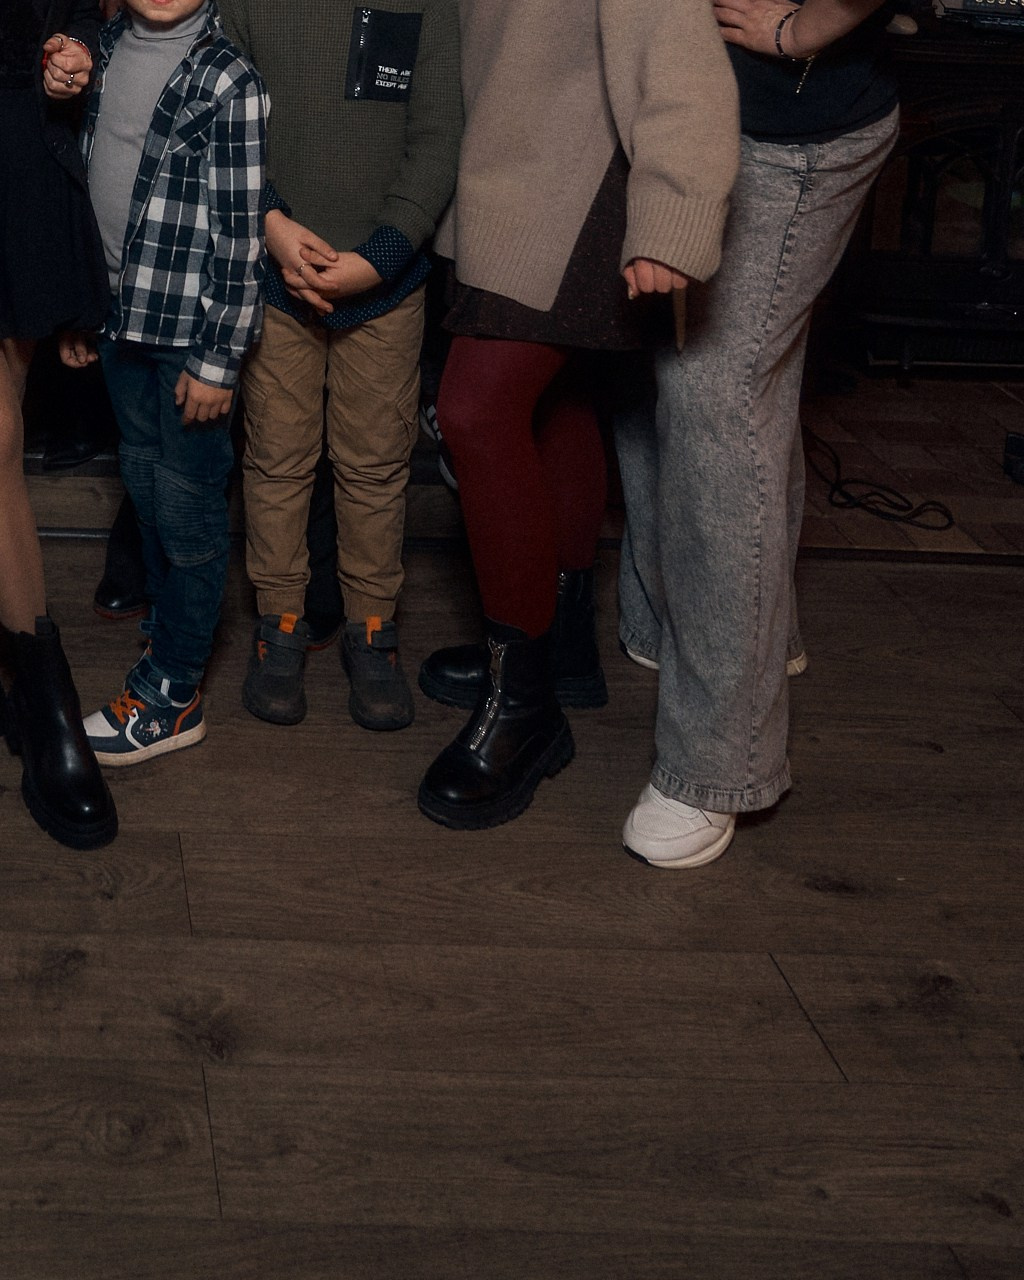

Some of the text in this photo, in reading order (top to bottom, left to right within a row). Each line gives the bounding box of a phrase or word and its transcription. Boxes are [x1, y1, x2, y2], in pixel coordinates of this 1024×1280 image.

[378, 65, 398, 75] THERE
[377, 72, 388, 80] NO
[375, 79, 397, 88] EXCEPT
